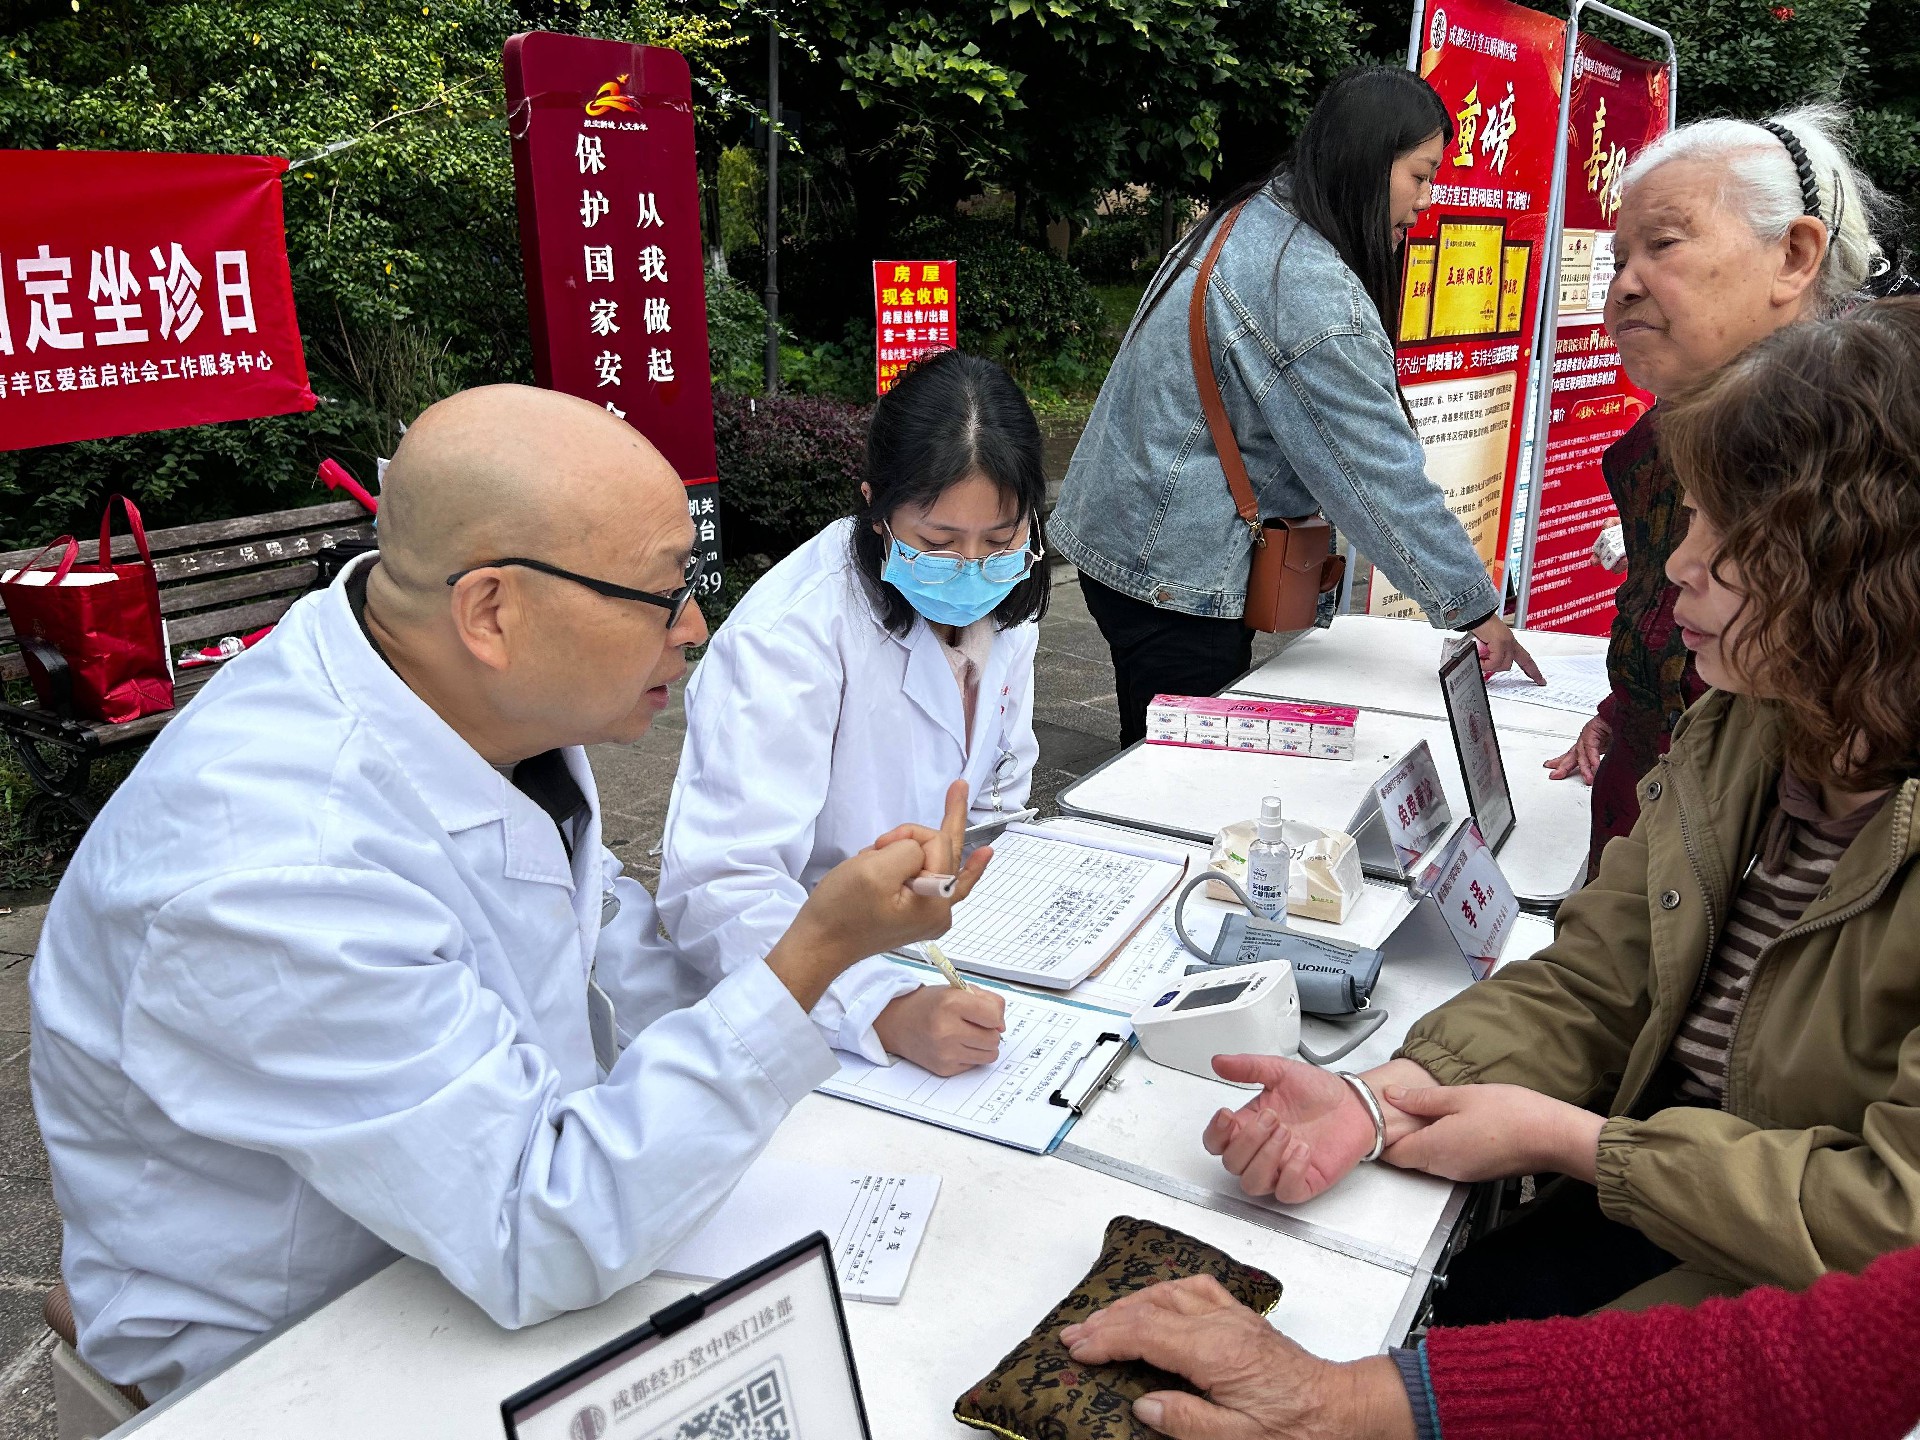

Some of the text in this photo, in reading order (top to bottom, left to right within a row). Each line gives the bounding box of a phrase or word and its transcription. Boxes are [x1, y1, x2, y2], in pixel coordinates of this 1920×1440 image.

[1448, 25, 1518, 62] 成都经方堂互联网医院
[1453, 81, 1517, 176] 重磅
[636, 193, 675, 382] 从我做起
[894, 265, 940, 282] 房屋
[1446, 266, 1493, 286] 互联网医院
[0, 242, 257, 355] 定坐诊日
[882, 287, 949, 306] 现金收购
[883, 328, 949, 343] 套一套二套三
[1398, 778, 1432, 830] 免费看诊
[1297, 962, 1347, 975] OMRON
[611, 1295, 793, 1416] 成都经方堂中医门诊部
